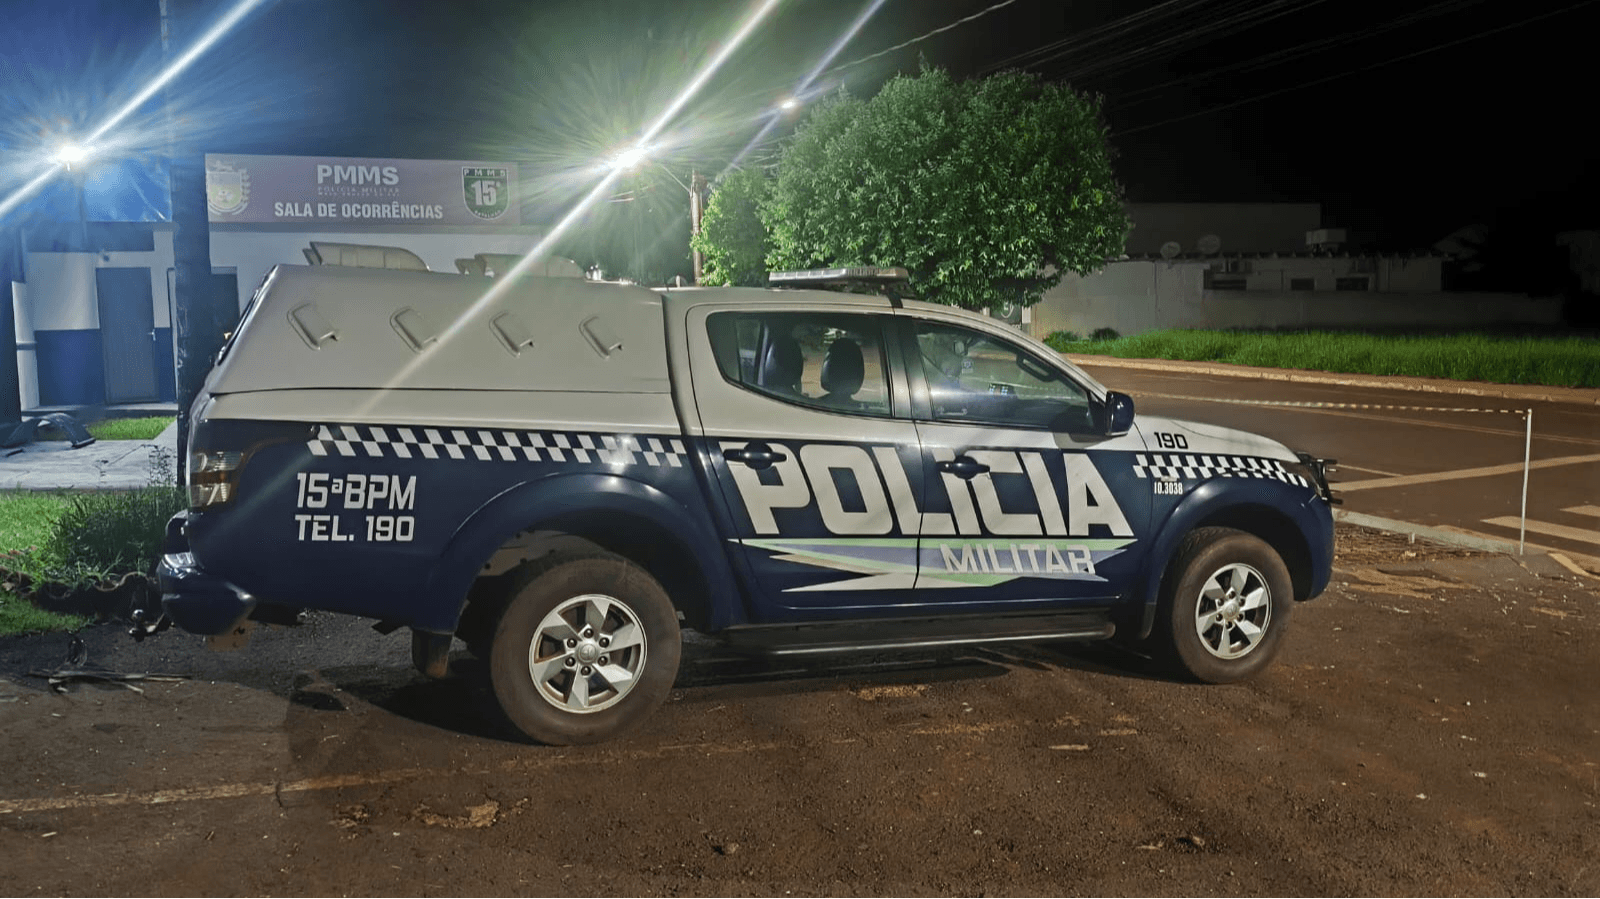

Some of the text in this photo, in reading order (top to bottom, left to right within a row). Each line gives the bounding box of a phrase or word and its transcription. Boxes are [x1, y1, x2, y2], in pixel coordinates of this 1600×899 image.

[317, 165, 399, 185] PMMS
[274, 201, 443, 219] SALA DE OCORRÊNCIAS
[1154, 431, 1189, 449] 190
[1154, 481, 1184, 495] 10.3038
[294, 514, 415, 542] TEL. 190
[940, 543, 1096, 575] MILITAR
